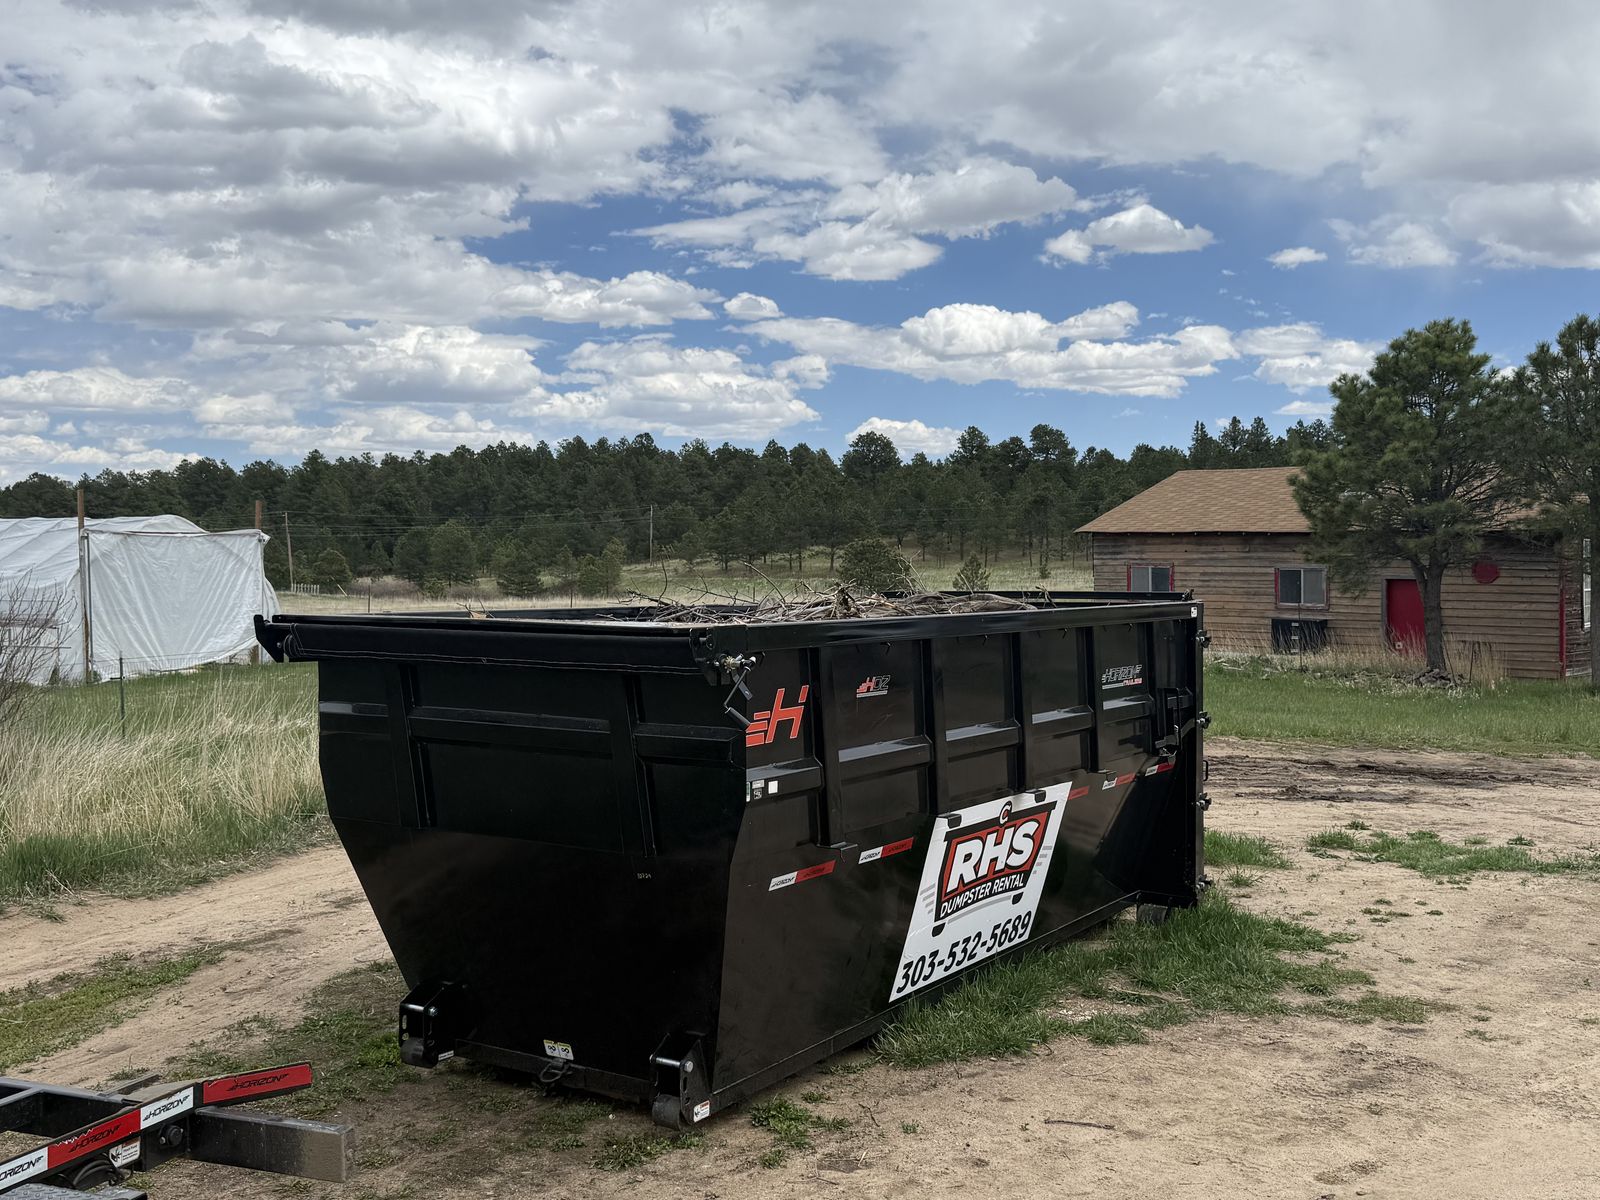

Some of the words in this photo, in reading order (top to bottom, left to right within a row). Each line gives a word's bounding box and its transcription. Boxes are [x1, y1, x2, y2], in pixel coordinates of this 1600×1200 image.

[946, 818, 1040, 894] RHS
[940, 882, 992, 918] DUMPSTER
[992, 873, 1024, 893] RENTAL
[896, 910, 1032, 994] 303-532-5689
[230, 1075, 284, 1090] HORIZON
[146, 1097, 187, 1119] HORIZON
[73, 1125, 118, 1150] HORIZON
[0, 1158, 38, 1181] ORIZON
